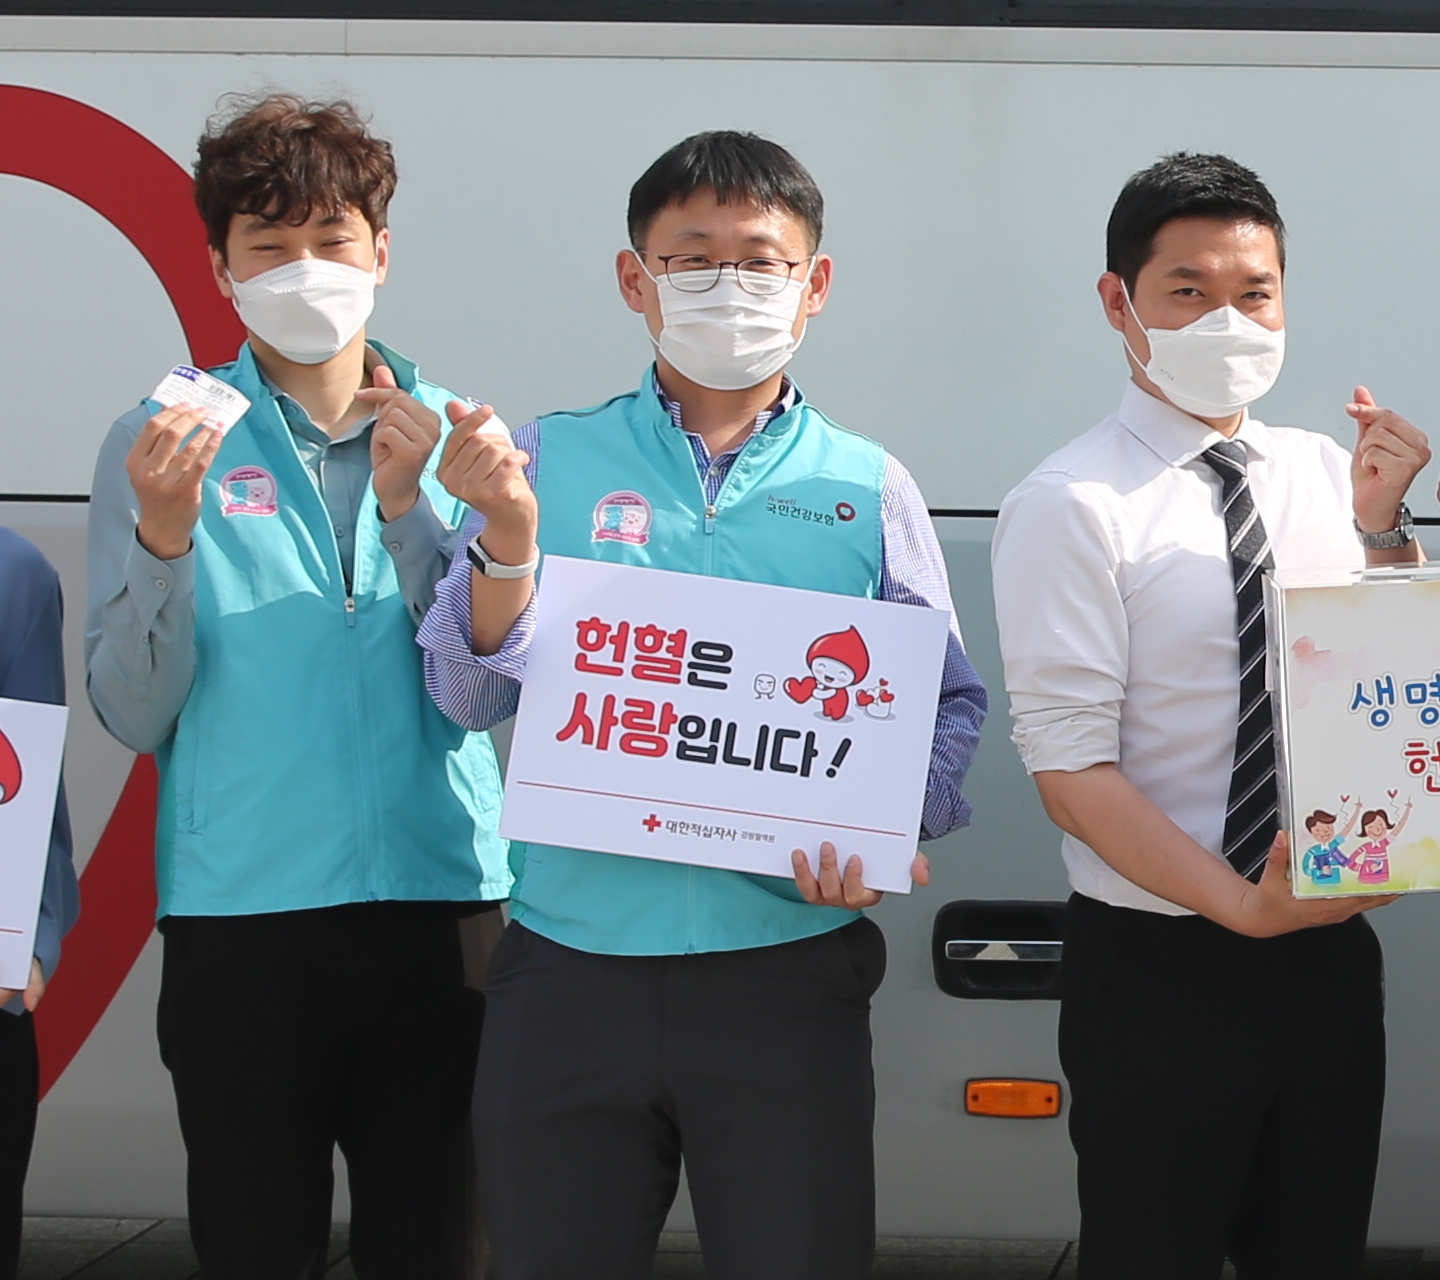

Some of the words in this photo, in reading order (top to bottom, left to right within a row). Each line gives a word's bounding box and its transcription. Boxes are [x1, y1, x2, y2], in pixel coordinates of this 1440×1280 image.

[765, 502, 835, 527] 국민건강보험
[573, 616, 733, 690] 헌혈은
[665, 819, 738, 842] 대한적십자사
